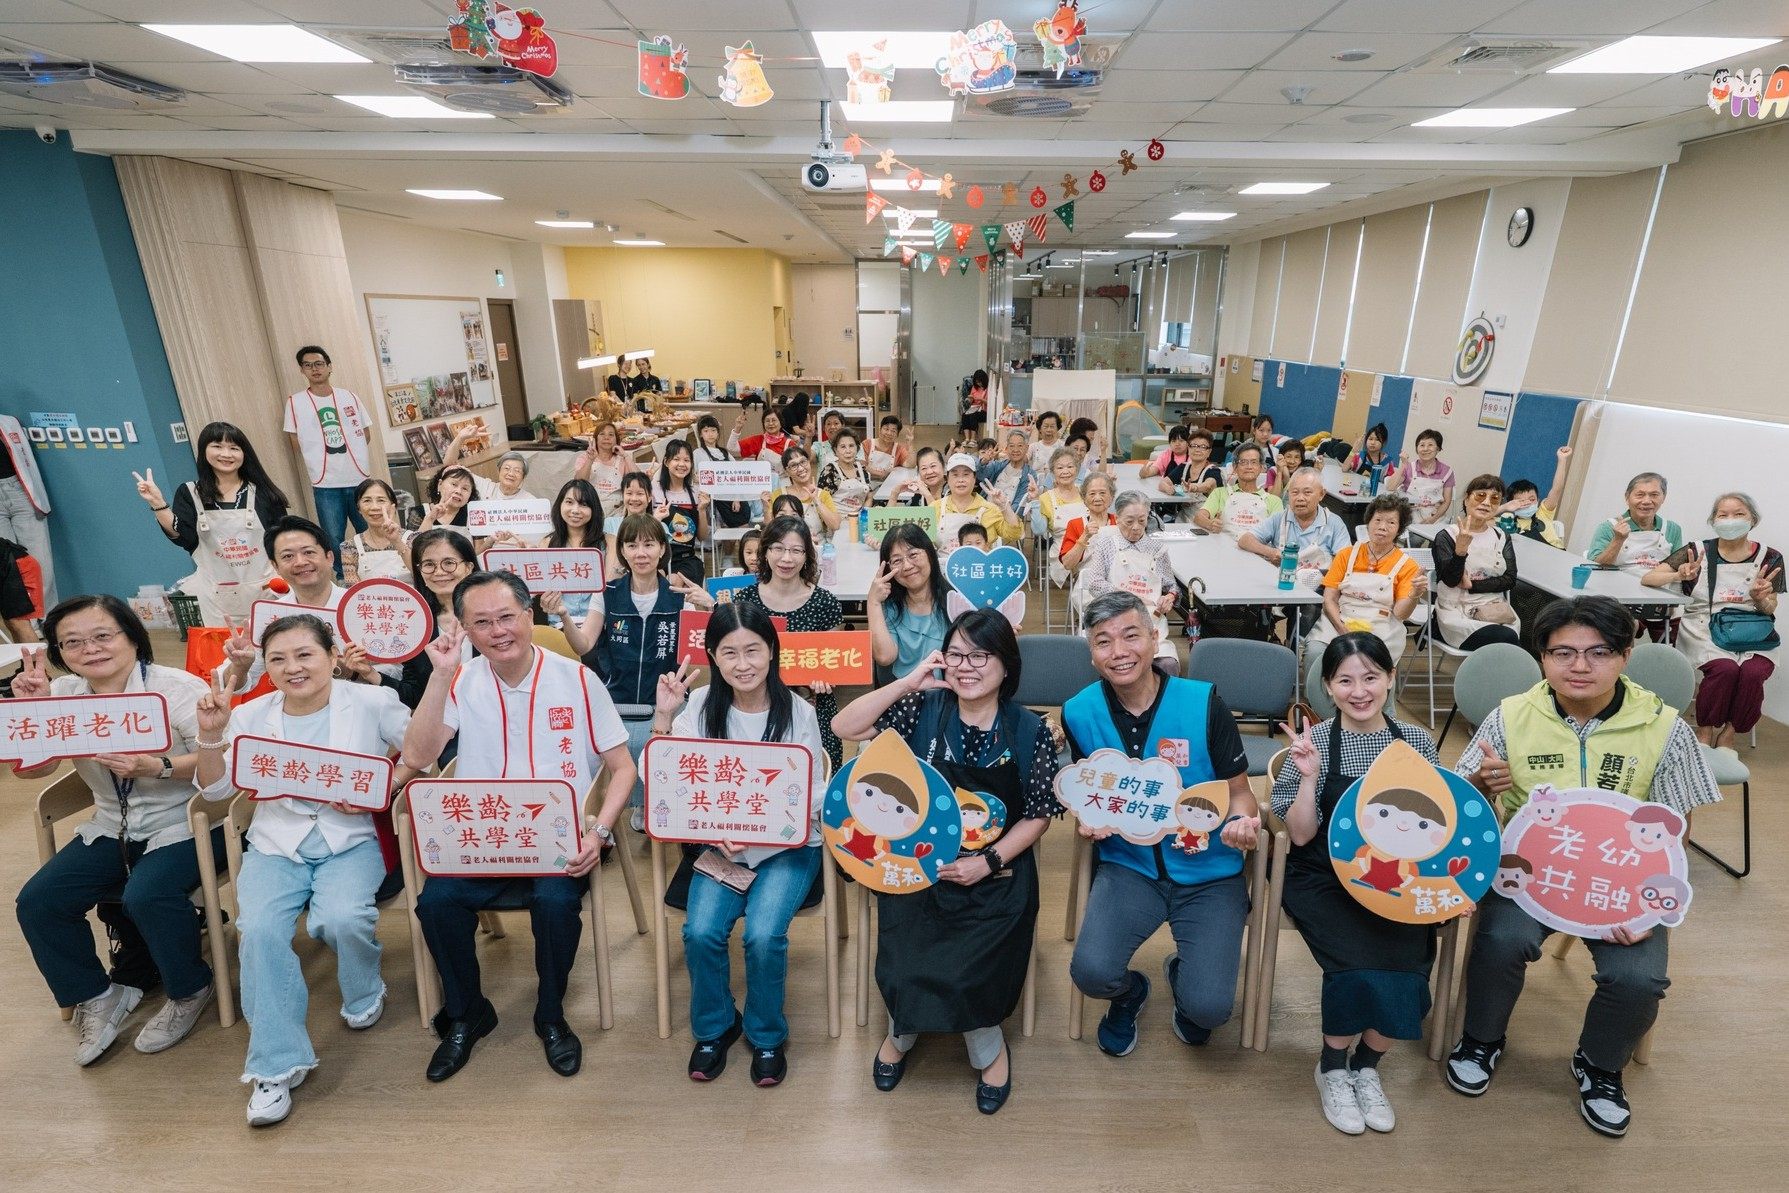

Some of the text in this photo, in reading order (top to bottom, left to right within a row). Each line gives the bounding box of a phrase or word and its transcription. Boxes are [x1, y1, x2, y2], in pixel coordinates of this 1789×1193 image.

[521, 51, 552, 60] Christmas
[526, 44, 549, 54] Merry
[230, 560, 251, 568] EWCA
[951, 563, 1023, 579] 社區共好
[357, 603, 396, 621] 樂齡
[363, 622, 409, 636] 共學堂
[610, 635, 629, 644] 大同區
[656, 620, 669, 660] 吳若屏
[779, 647, 863, 670] 幸福老化
[7, 712, 153, 741] 活躍老化
[558, 736, 577, 778] 老協
[677, 752, 748, 787] 樂齡
[250, 753, 375, 794] 樂齡學習
[1075, 767, 1164, 799] 兒童的事
[441, 792, 513, 823] 樂齡
[687, 790, 770, 816] 共學堂
[1084, 792, 1172, 823] 大家的事
[457, 826, 539, 849] 共學堂
[700, 821, 767, 832] 老人福利關懷協會
[1548, 824, 1642, 868] 老幼
[473, 855, 540, 864] 老人福利關懷協會
[1410, 885, 1465, 916] 萬和
[1536, 865, 1631, 913] 共融
